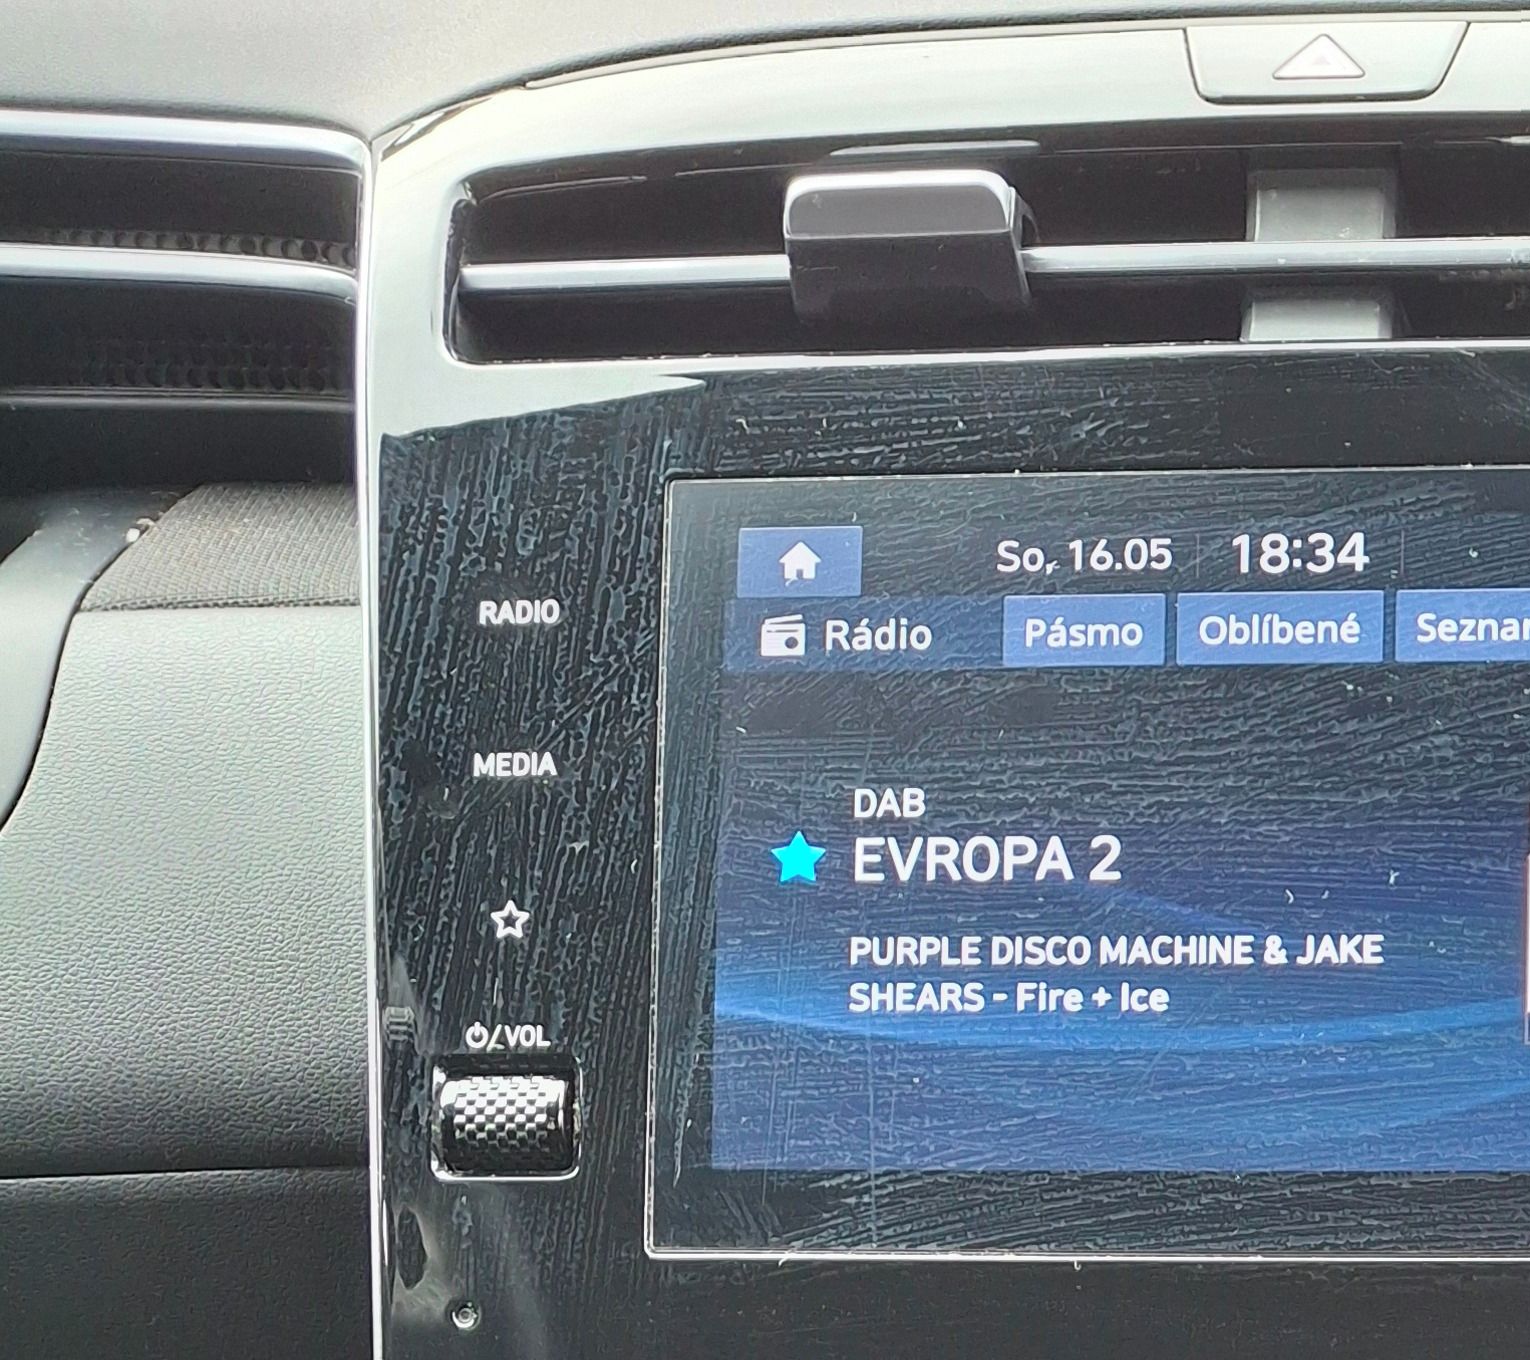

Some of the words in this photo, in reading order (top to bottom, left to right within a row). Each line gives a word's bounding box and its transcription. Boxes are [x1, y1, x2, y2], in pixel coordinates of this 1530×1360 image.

[1069, 537, 1173, 571] 16.05
[1231, 532, 1370, 574] 18:34
[478, 599, 560, 626] RADIO
[824, 620, 933, 652] Rádio
[1025, 617, 1144, 648] Pásmo
[1199, 612, 1361, 646] Oblíbené
[473, 752, 557, 778] MEDIA
[853, 787, 926, 819] DAB
[853, 836, 1075, 883] EVROPA
[1088, 835, 1124, 882] 2
[849, 935, 982, 967] PURPLE
[991, 935, 1092, 966] DISCO
[1100, 934, 1255, 965] MACHINE
[1264, 934, 1288, 965] &
[1296, 933, 1385, 965] JAKE
[848, 983, 986, 1013] SHEARS
[1016, 981, 1083, 1011] Fire
[1090, 988, 1113, 1008] +
[1120, 982, 1170, 1011] Ice
